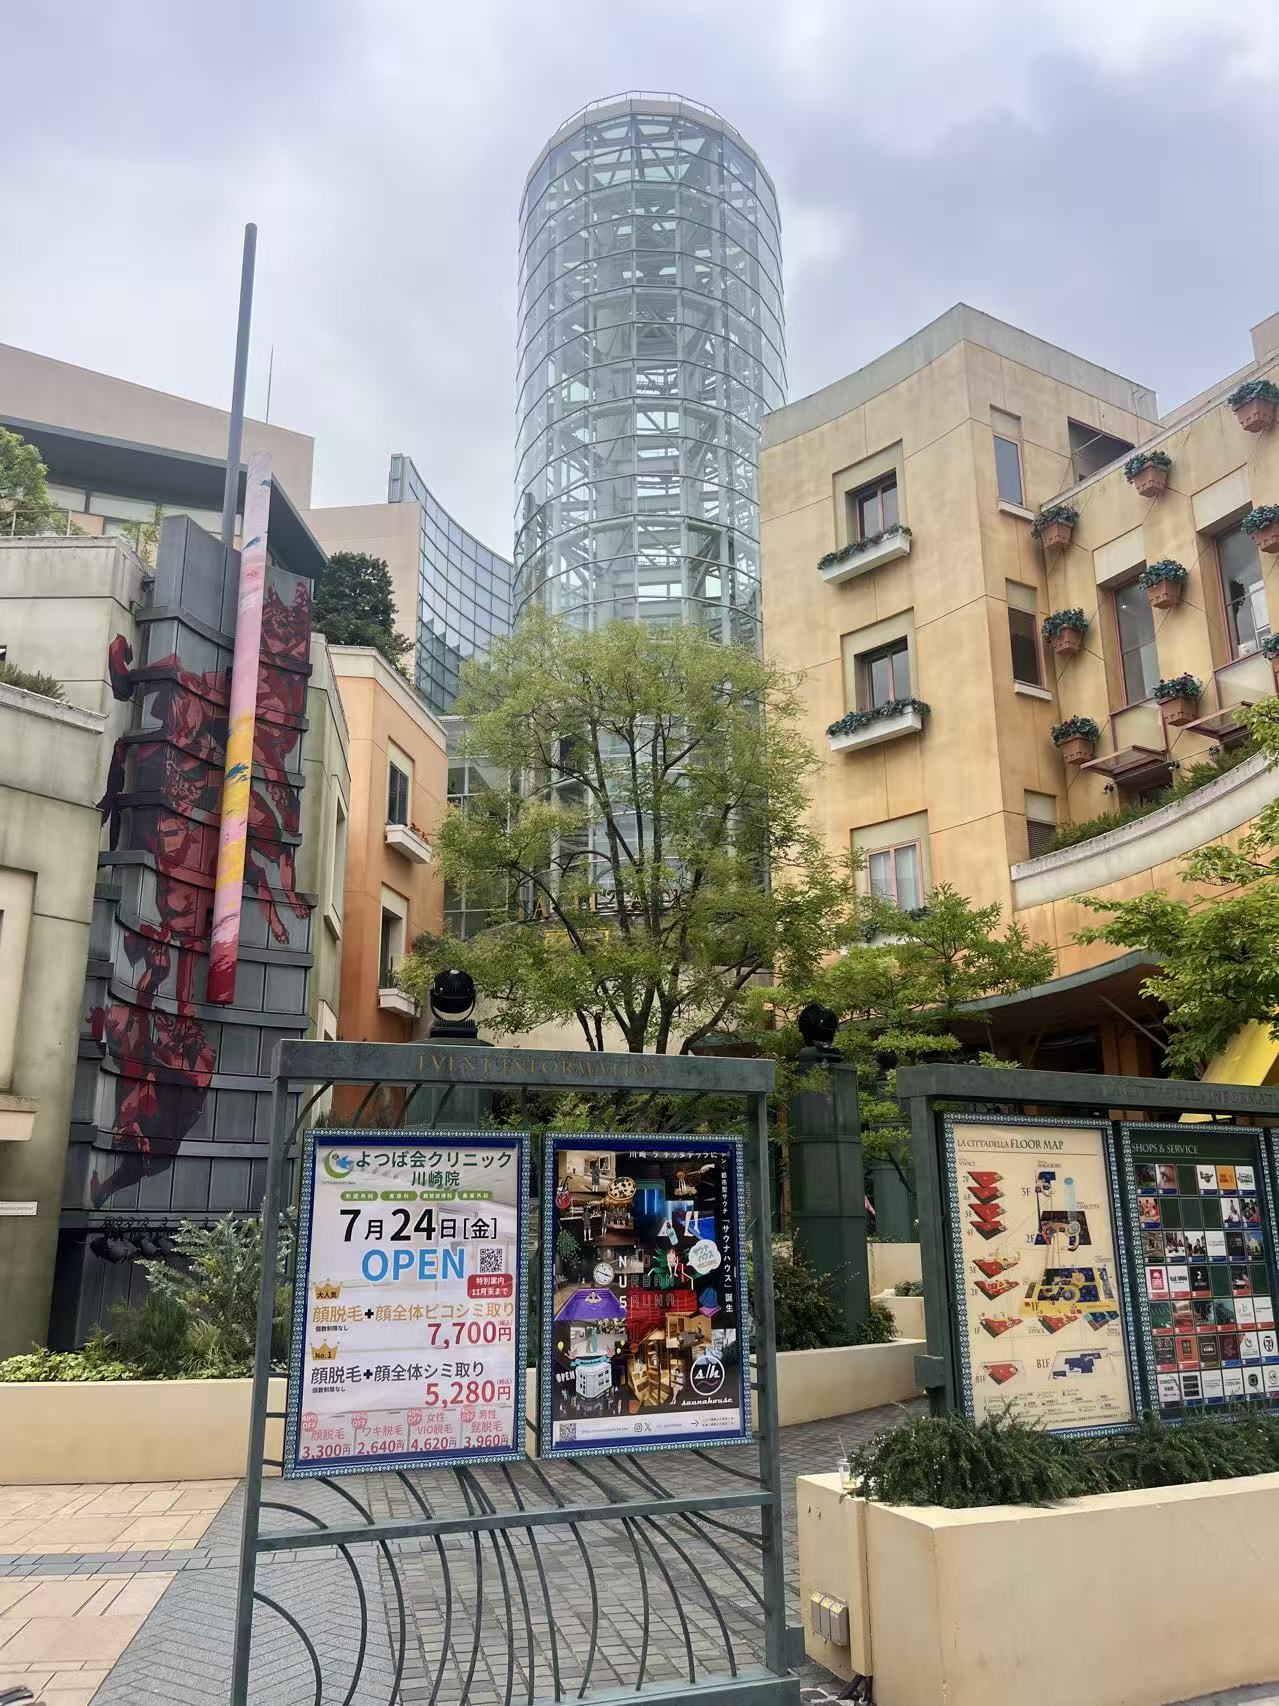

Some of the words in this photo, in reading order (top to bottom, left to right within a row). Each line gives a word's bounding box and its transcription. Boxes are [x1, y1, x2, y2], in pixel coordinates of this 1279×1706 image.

[1010, 1139, 1041, 1149] FLOOR
[1043, 1140, 1064, 1150] MAP
[1131, 1143, 1158, 1153] SHOPS
[1166, 1144, 1199, 1154] SERVICE
[356, 1150, 512, 1169] よつば会クリニック
[411, 1170, 460, 1187] 川崎院
[361, 1247, 466, 1282] OPEN
[476, 1276, 505, 1286] 特別案内
[316, 1291, 337, 1299] 大人気
[471, 1287, 509, 1296] 11月末まで
[428, 1321, 512, 1349] 7,700円
[556, 1371, 576, 1383] OPEN
[425, 1380, 511, 1408] 5,280円
[681, 1397, 734, 1406] saunahouse
[408, 1416, 421, 1424] OFF
[311, 1427, 345, 1441] 顔脱毛
[362, 1424, 404, 1437] ワキ脱毛
